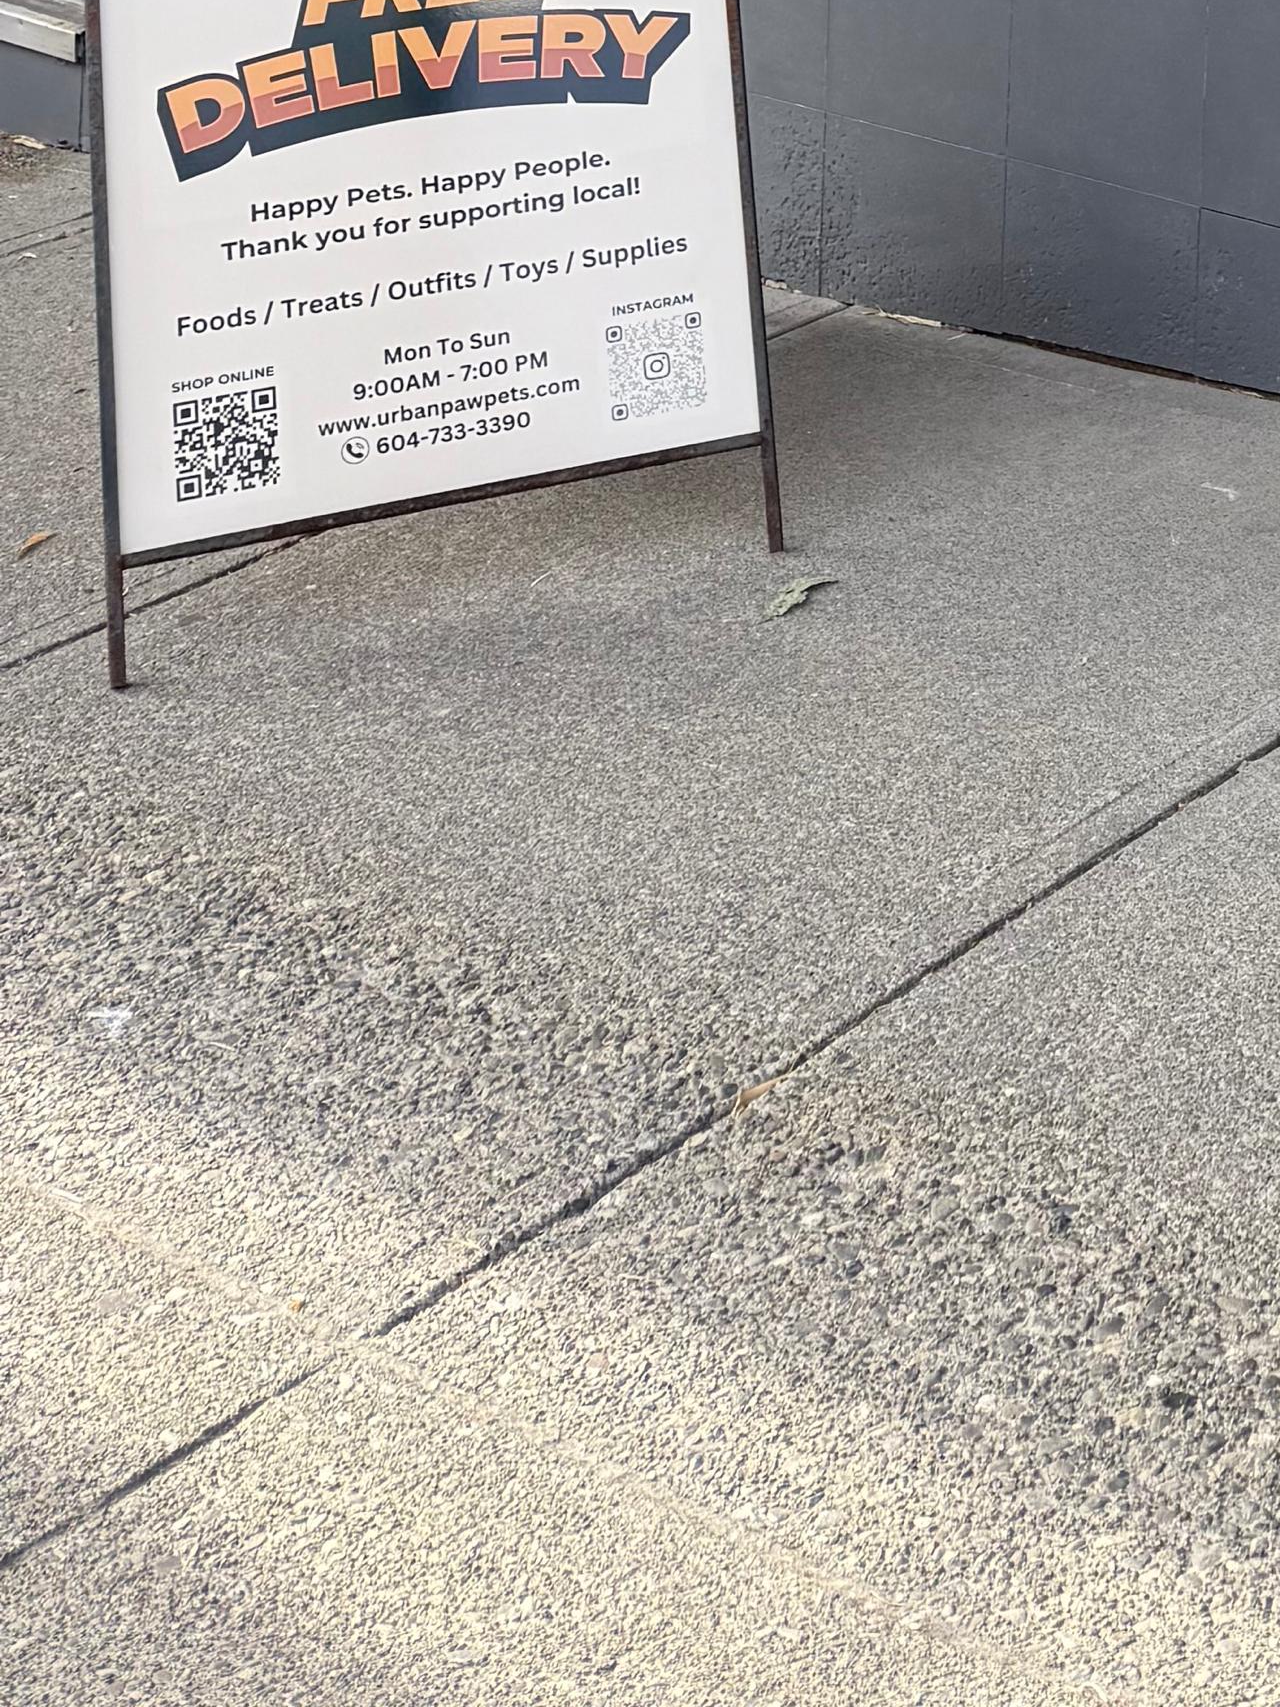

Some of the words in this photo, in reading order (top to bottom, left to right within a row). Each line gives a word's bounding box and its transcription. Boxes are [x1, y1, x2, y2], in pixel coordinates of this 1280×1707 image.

[160, 12, 686, 162] DELIVERY
[251, 195, 339, 223] Happy
[347, 184, 414, 207] Pets.
[420, 168, 506, 195] Happy
[514, 151, 611, 180] People.
[221, 231, 309, 261] Thank
[315, 224, 366, 251] you
[373, 216, 412, 238] for
[418, 193, 564, 230] supporting
[573, 176, 641, 205] local!
[177, 306, 257, 337] Foods
[263, 300, 274, 325] /
[281, 290, 363, 318] Treats
[370, 283, 380, 307] /
[388, 271, 477, 301] Outfits
[483, 264, 492, 288] /
[499, 258, 559, 283] Toys
[565, 251, 575, 274] /
[582, 236, 688, 269] Supplies
[611, 293, 695, 317] INSTAGRAM
[384, 345, 431, 365] Mon
[436, 338, 464, 355] To
[470, 331, 511, 350] Sun
[171, 376, 214, 393] SHOP
[218, 366, 275, 385] ONLINE
[353, 370, 441, 401] 9:00AM
[460, 358, 508, 382] 7:00
[515, 351, 549, 372] PM
[318, 378, 581, 436] www.urbanpawpets.com
[376, 411, 532, 454] 604-733-3390
